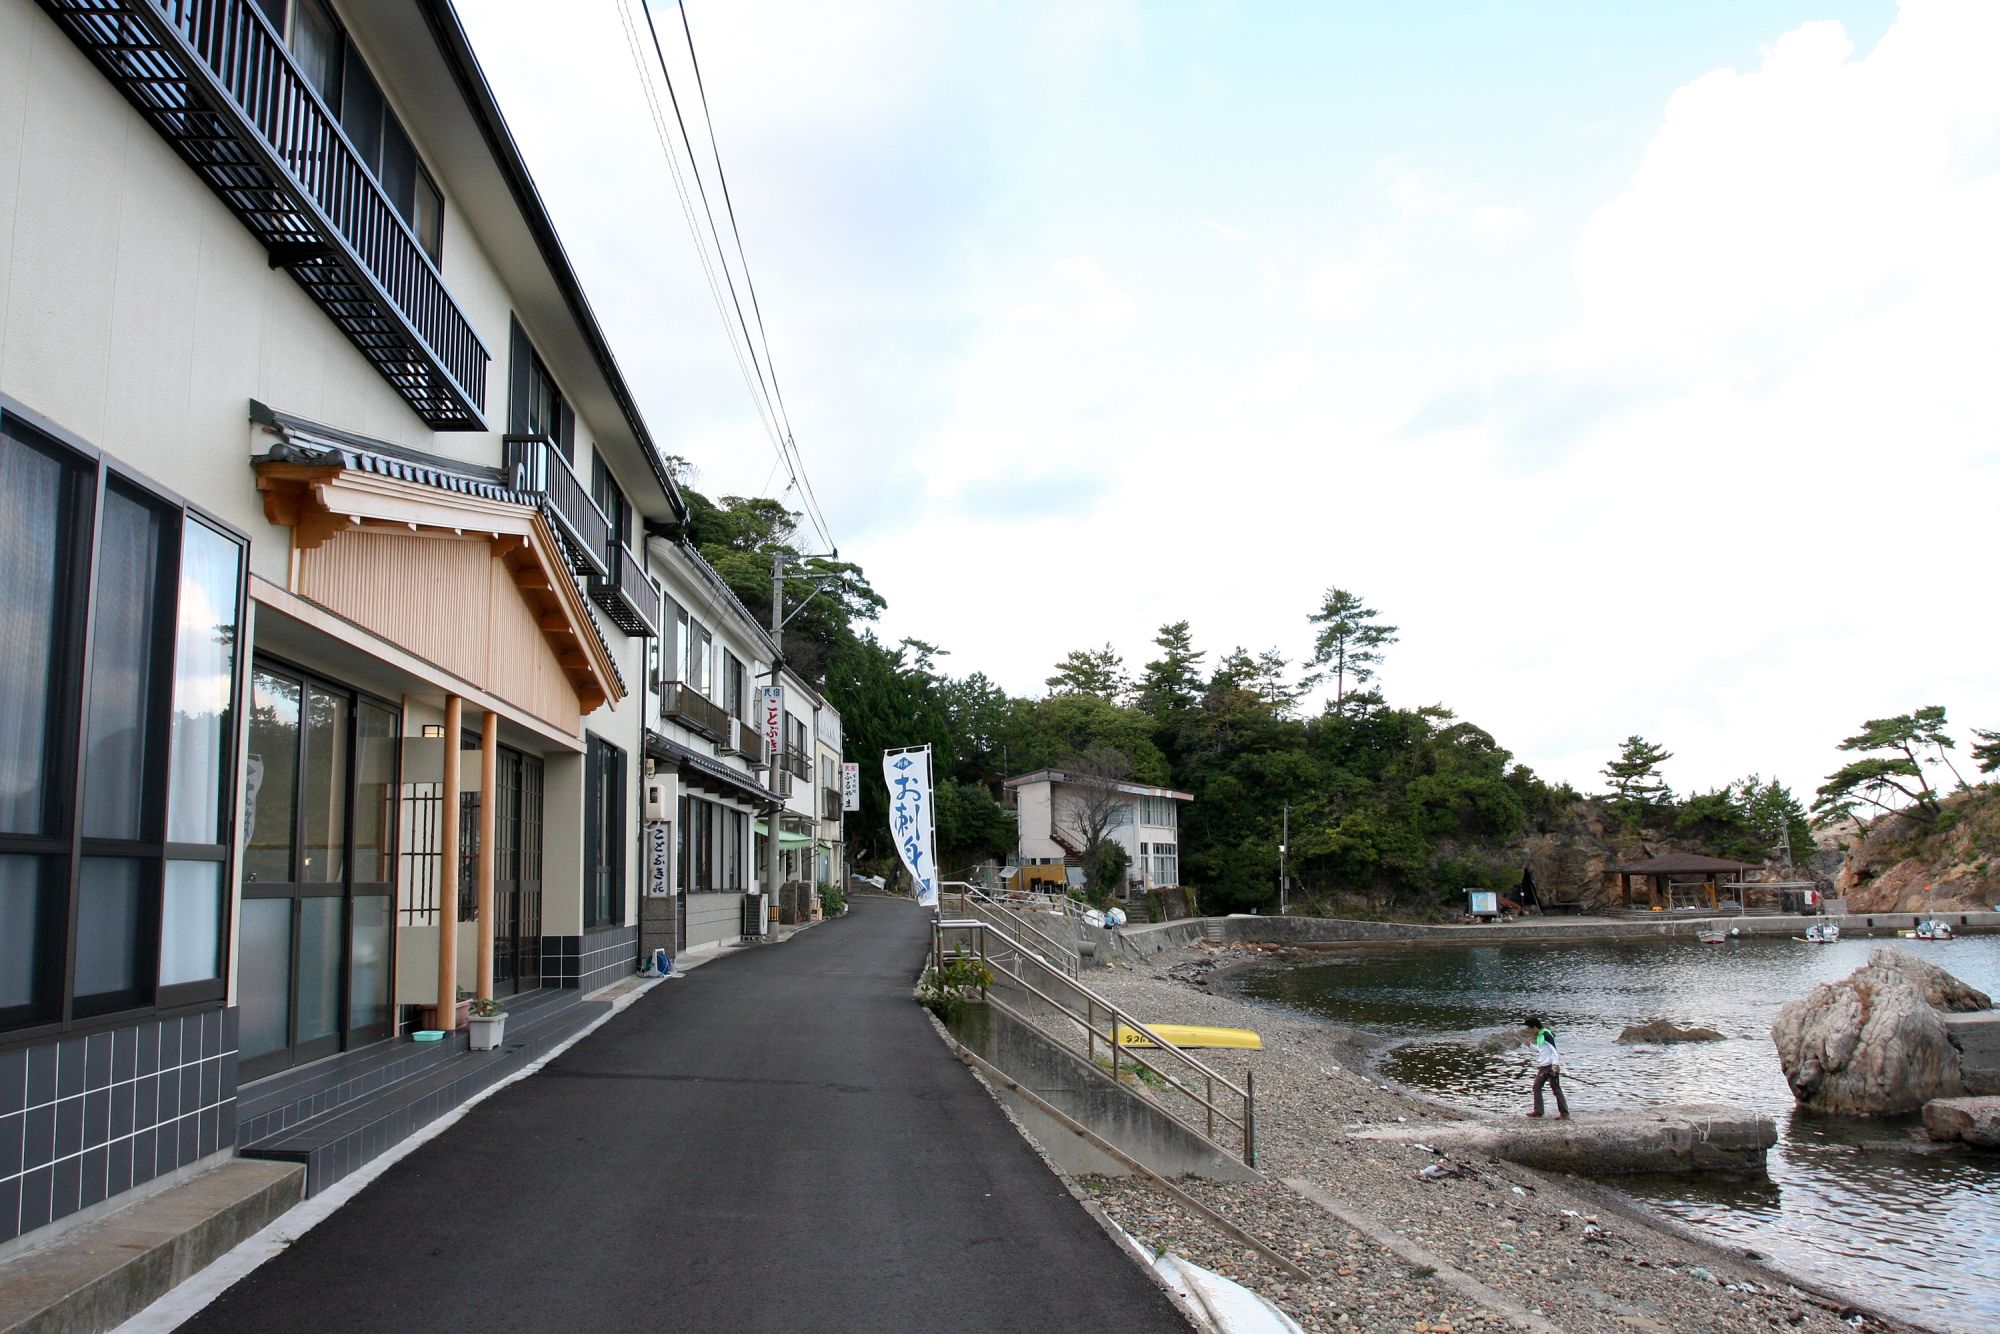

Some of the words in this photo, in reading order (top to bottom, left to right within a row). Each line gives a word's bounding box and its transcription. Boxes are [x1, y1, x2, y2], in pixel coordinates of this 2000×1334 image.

[763, 688, 781, 698] 民宿
[894, 773, 924, 879] お刺身
